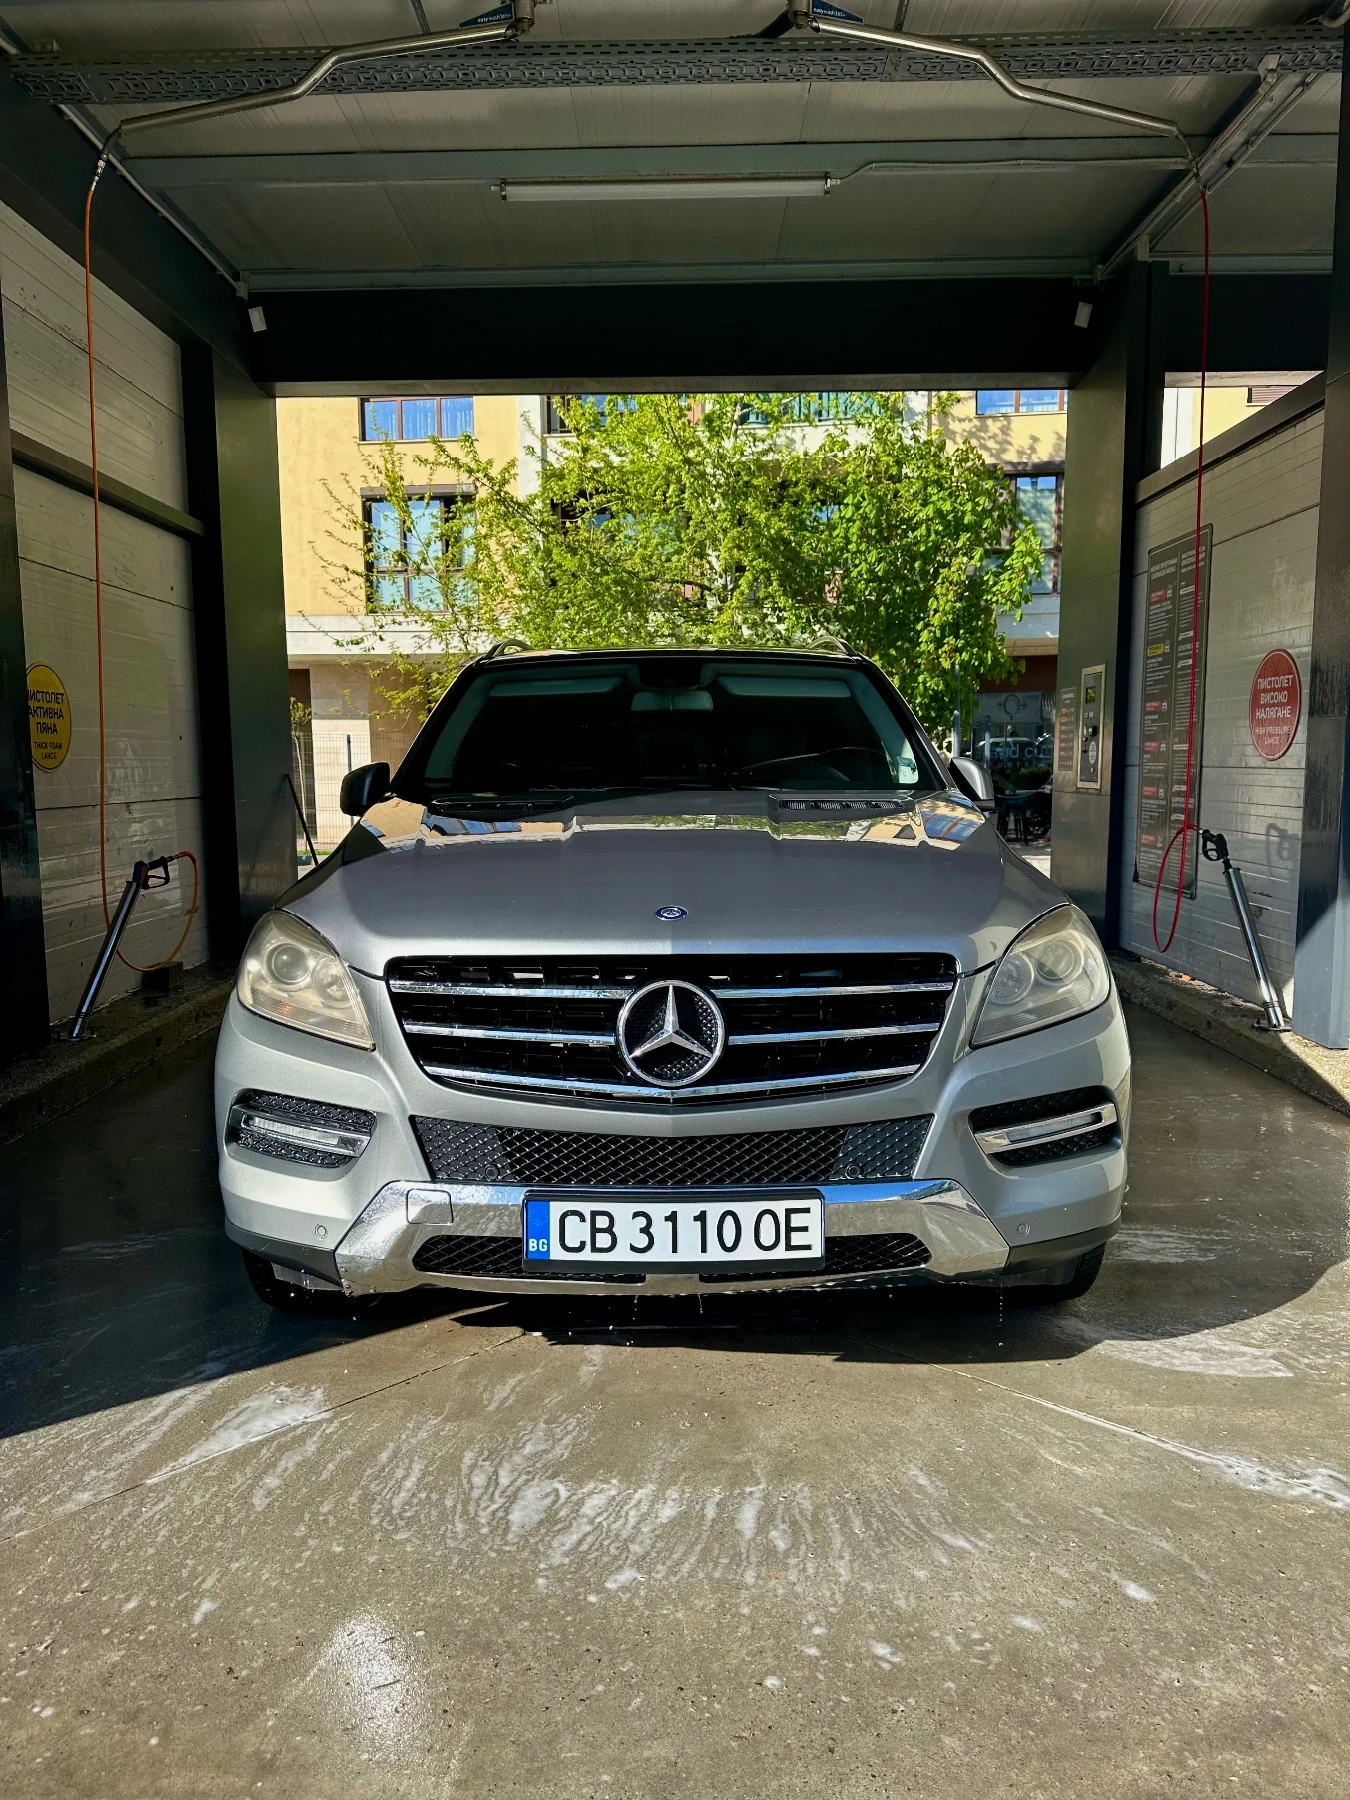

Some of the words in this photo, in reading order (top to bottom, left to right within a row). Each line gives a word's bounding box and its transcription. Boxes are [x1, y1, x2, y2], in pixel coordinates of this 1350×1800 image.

[1257, 675, 1293, 690] ПИСТОЛЕТ
[1260, 690, 1288, 704] ВИСОКО
[29, 705, 64, 720] АКТИВНА
[1255, 705, 1292, 720] НАЛЯГАНЕ
[36, 721, 58, 735] ПЯНА
[34, 741, 49, 750] THICK
[49, 741, 62, 750] FOAM
[41, 751, 57, 760] LANCE
[558, 1209, 618, 1254] CB
[629, 1209, 742, 1254] 3110
[753, 1207, 813, 1252] OE
[528, 1238, 548, 1252] BG
